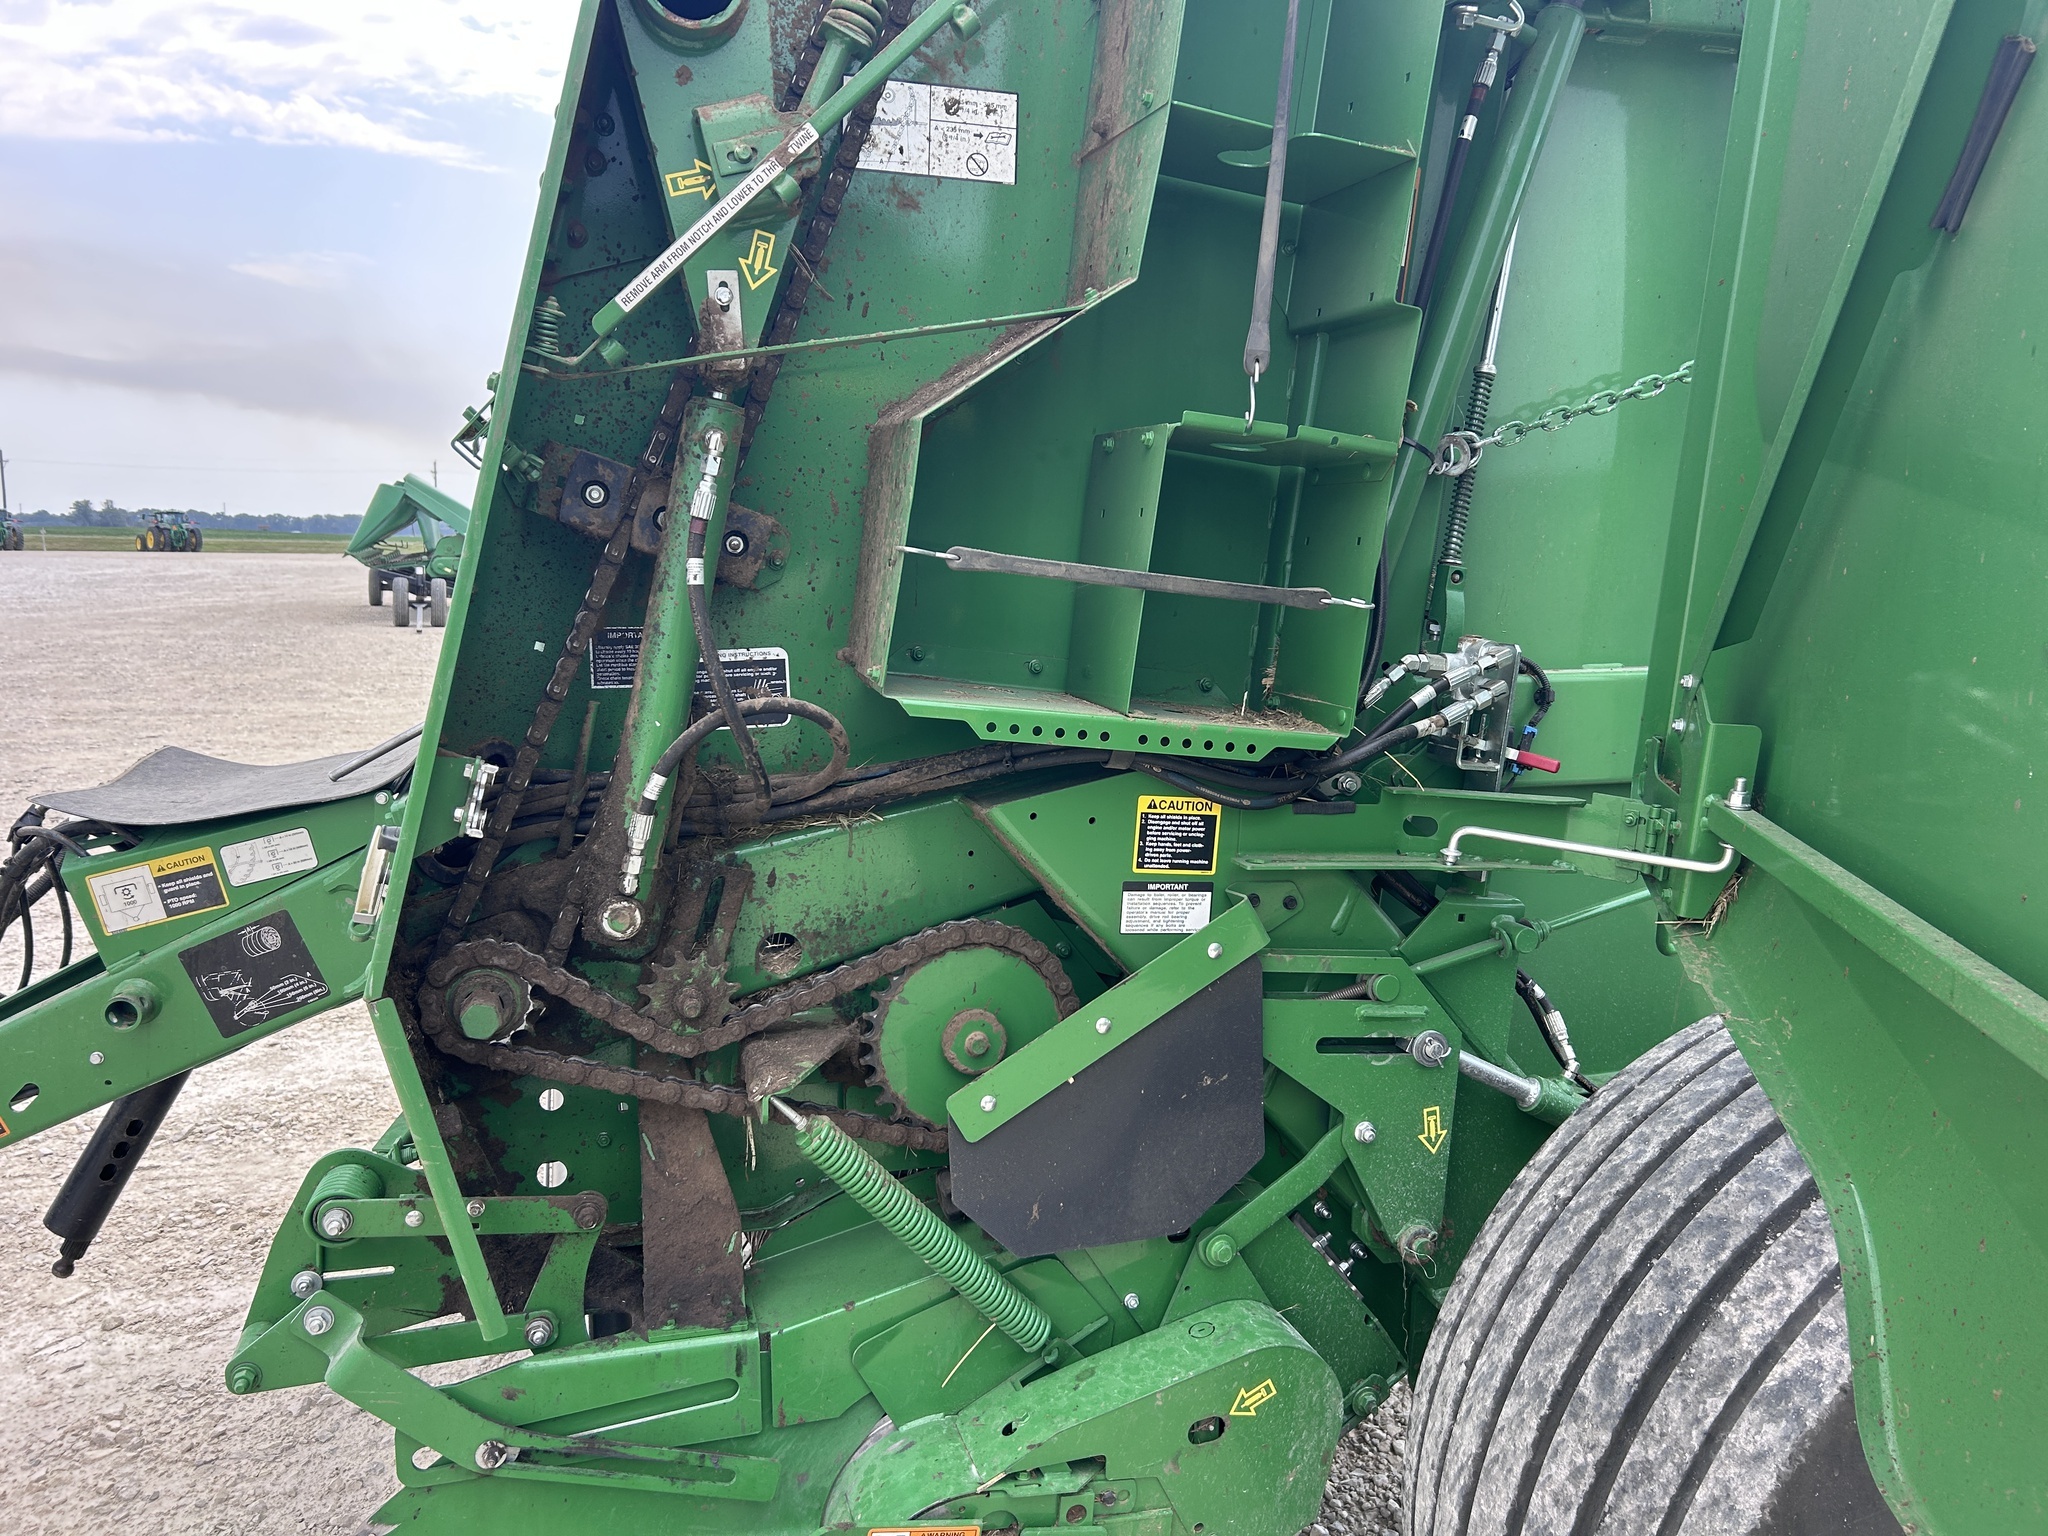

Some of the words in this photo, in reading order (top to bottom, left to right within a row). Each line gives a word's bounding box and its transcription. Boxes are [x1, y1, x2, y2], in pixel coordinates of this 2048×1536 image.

[620, 278, 653, 307] REMOVE
[650, 261, 668, 280] ARM
[667, 241, 690, 265] FROM
[690, 220, 714, 246] NOTCH
[712, 206, 730, 224] AND
[727, 183, 754, 211] LOWER
[752, 174, 764, 187] TO
[789, 128, 814, 153] TWINE
[1158, 800, 1213, 812] CAUTION
[166, 854, 206, 870] CAUTION
[183, 874, 202, 883] shields
